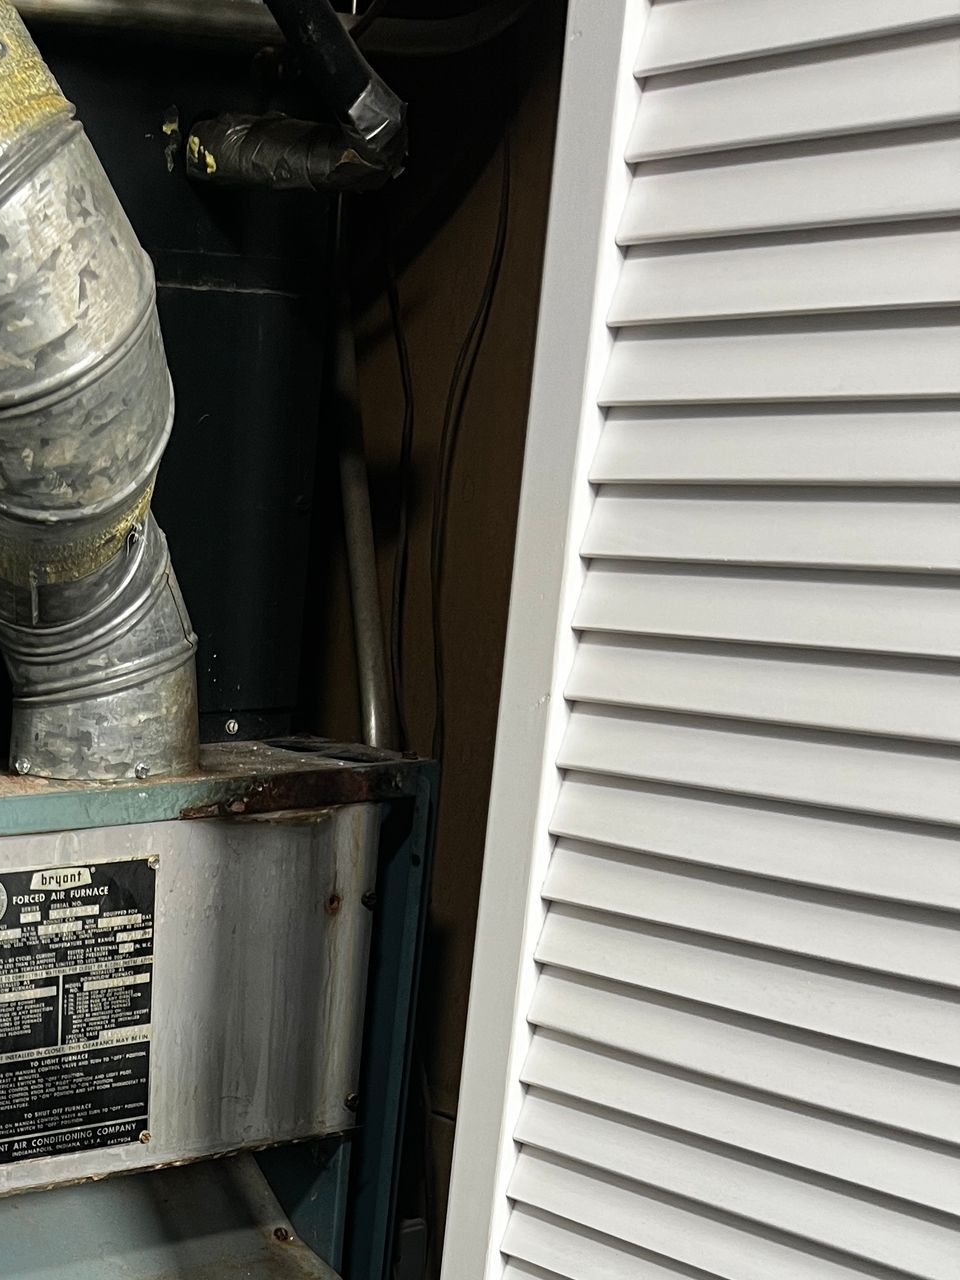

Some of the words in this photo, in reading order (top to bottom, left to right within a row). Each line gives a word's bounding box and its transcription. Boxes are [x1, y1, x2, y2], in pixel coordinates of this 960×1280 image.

[41, 870, 83, 888] bryant
[12, 892, 46, 906] FORCED
[50, 890, 66, 902] AIR
[69, 885, 109, 899] FURNACE
[50, 902, 70, 910] SERIAL
[5, 1051, 36, 1061] INSTALLED
[68, 1043, 81, 1052] THIS
[82, 1039, 115, 1050] CLEARANCE
[115, 1037, 130, 1045] MAY
[30, 1060, 40, 1068] TO
[41, 1056, 59, 1067] LIGHT
[61, 1053, 89, 1064] FURNACE
[24, 1112, 33, 1120] TO
[34, 1109, 51, 1118] SHUT
[51, 1107, 64, 1115] OFF
[64, 1103, 92, 1113] FURNACE
[12, 1140, 28, 1151] AIR
[31, 1129, 93, 1148] CONDITIONING
[96, 1121, 138, 1136] COMPANY
[55, 1140, 81, 1151] INDIANA
